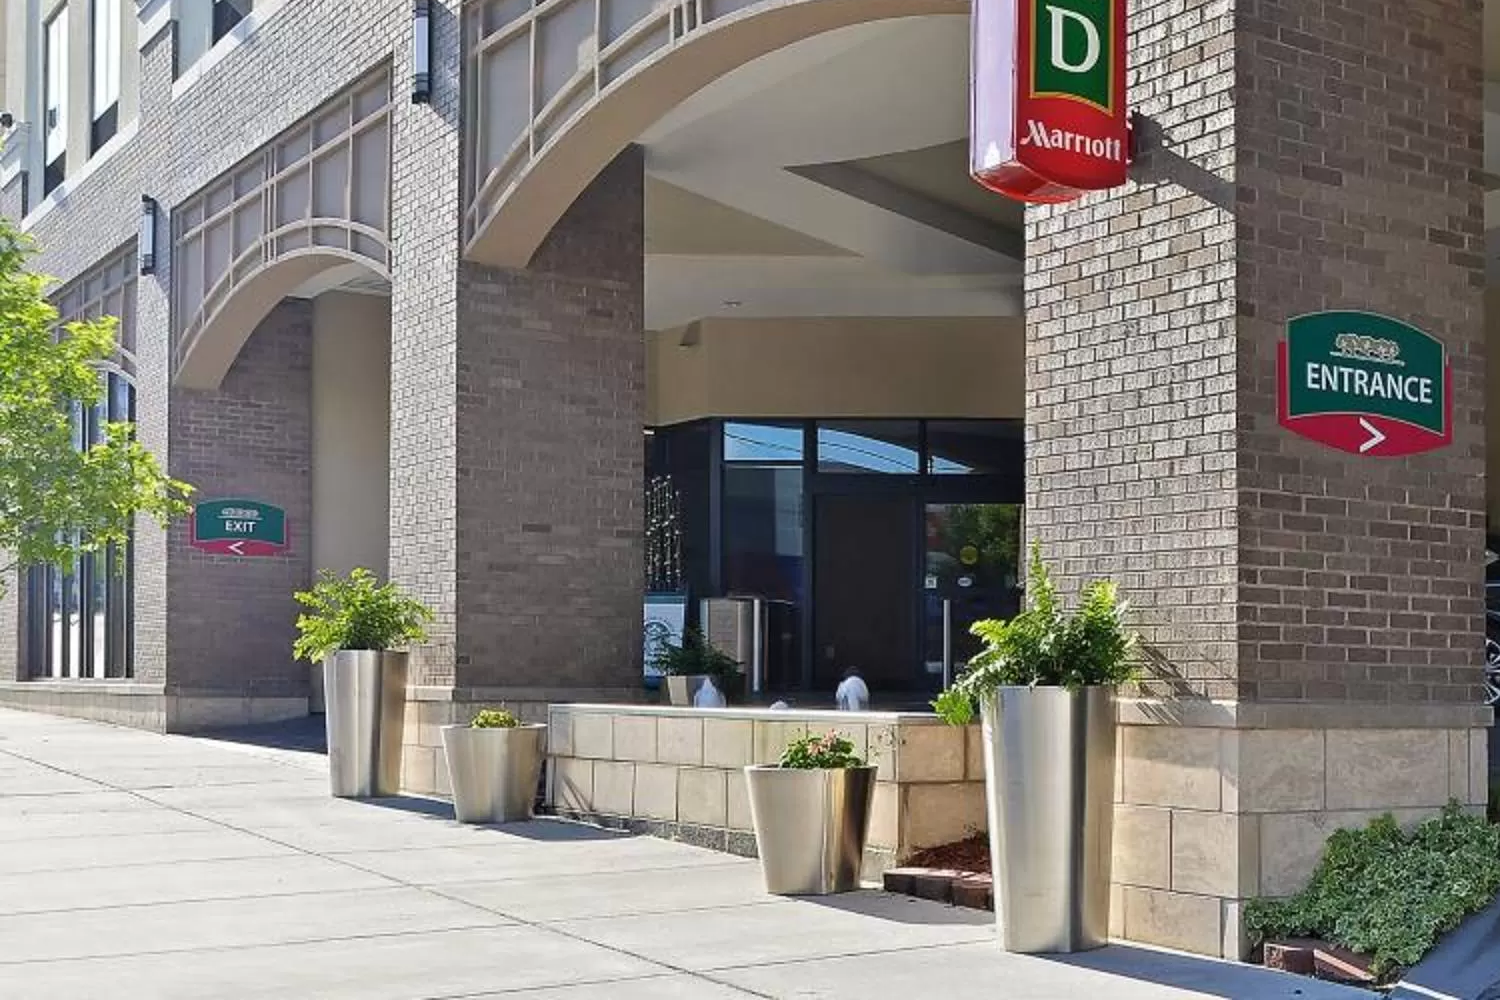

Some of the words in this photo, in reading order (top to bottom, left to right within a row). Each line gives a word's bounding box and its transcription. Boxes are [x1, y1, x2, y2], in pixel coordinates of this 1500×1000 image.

[1020, 119, 1120, 161] Marriott
[1306, 362, 1433, 404] ENTRANCE
[225, 520, 257, 533] EXIT
